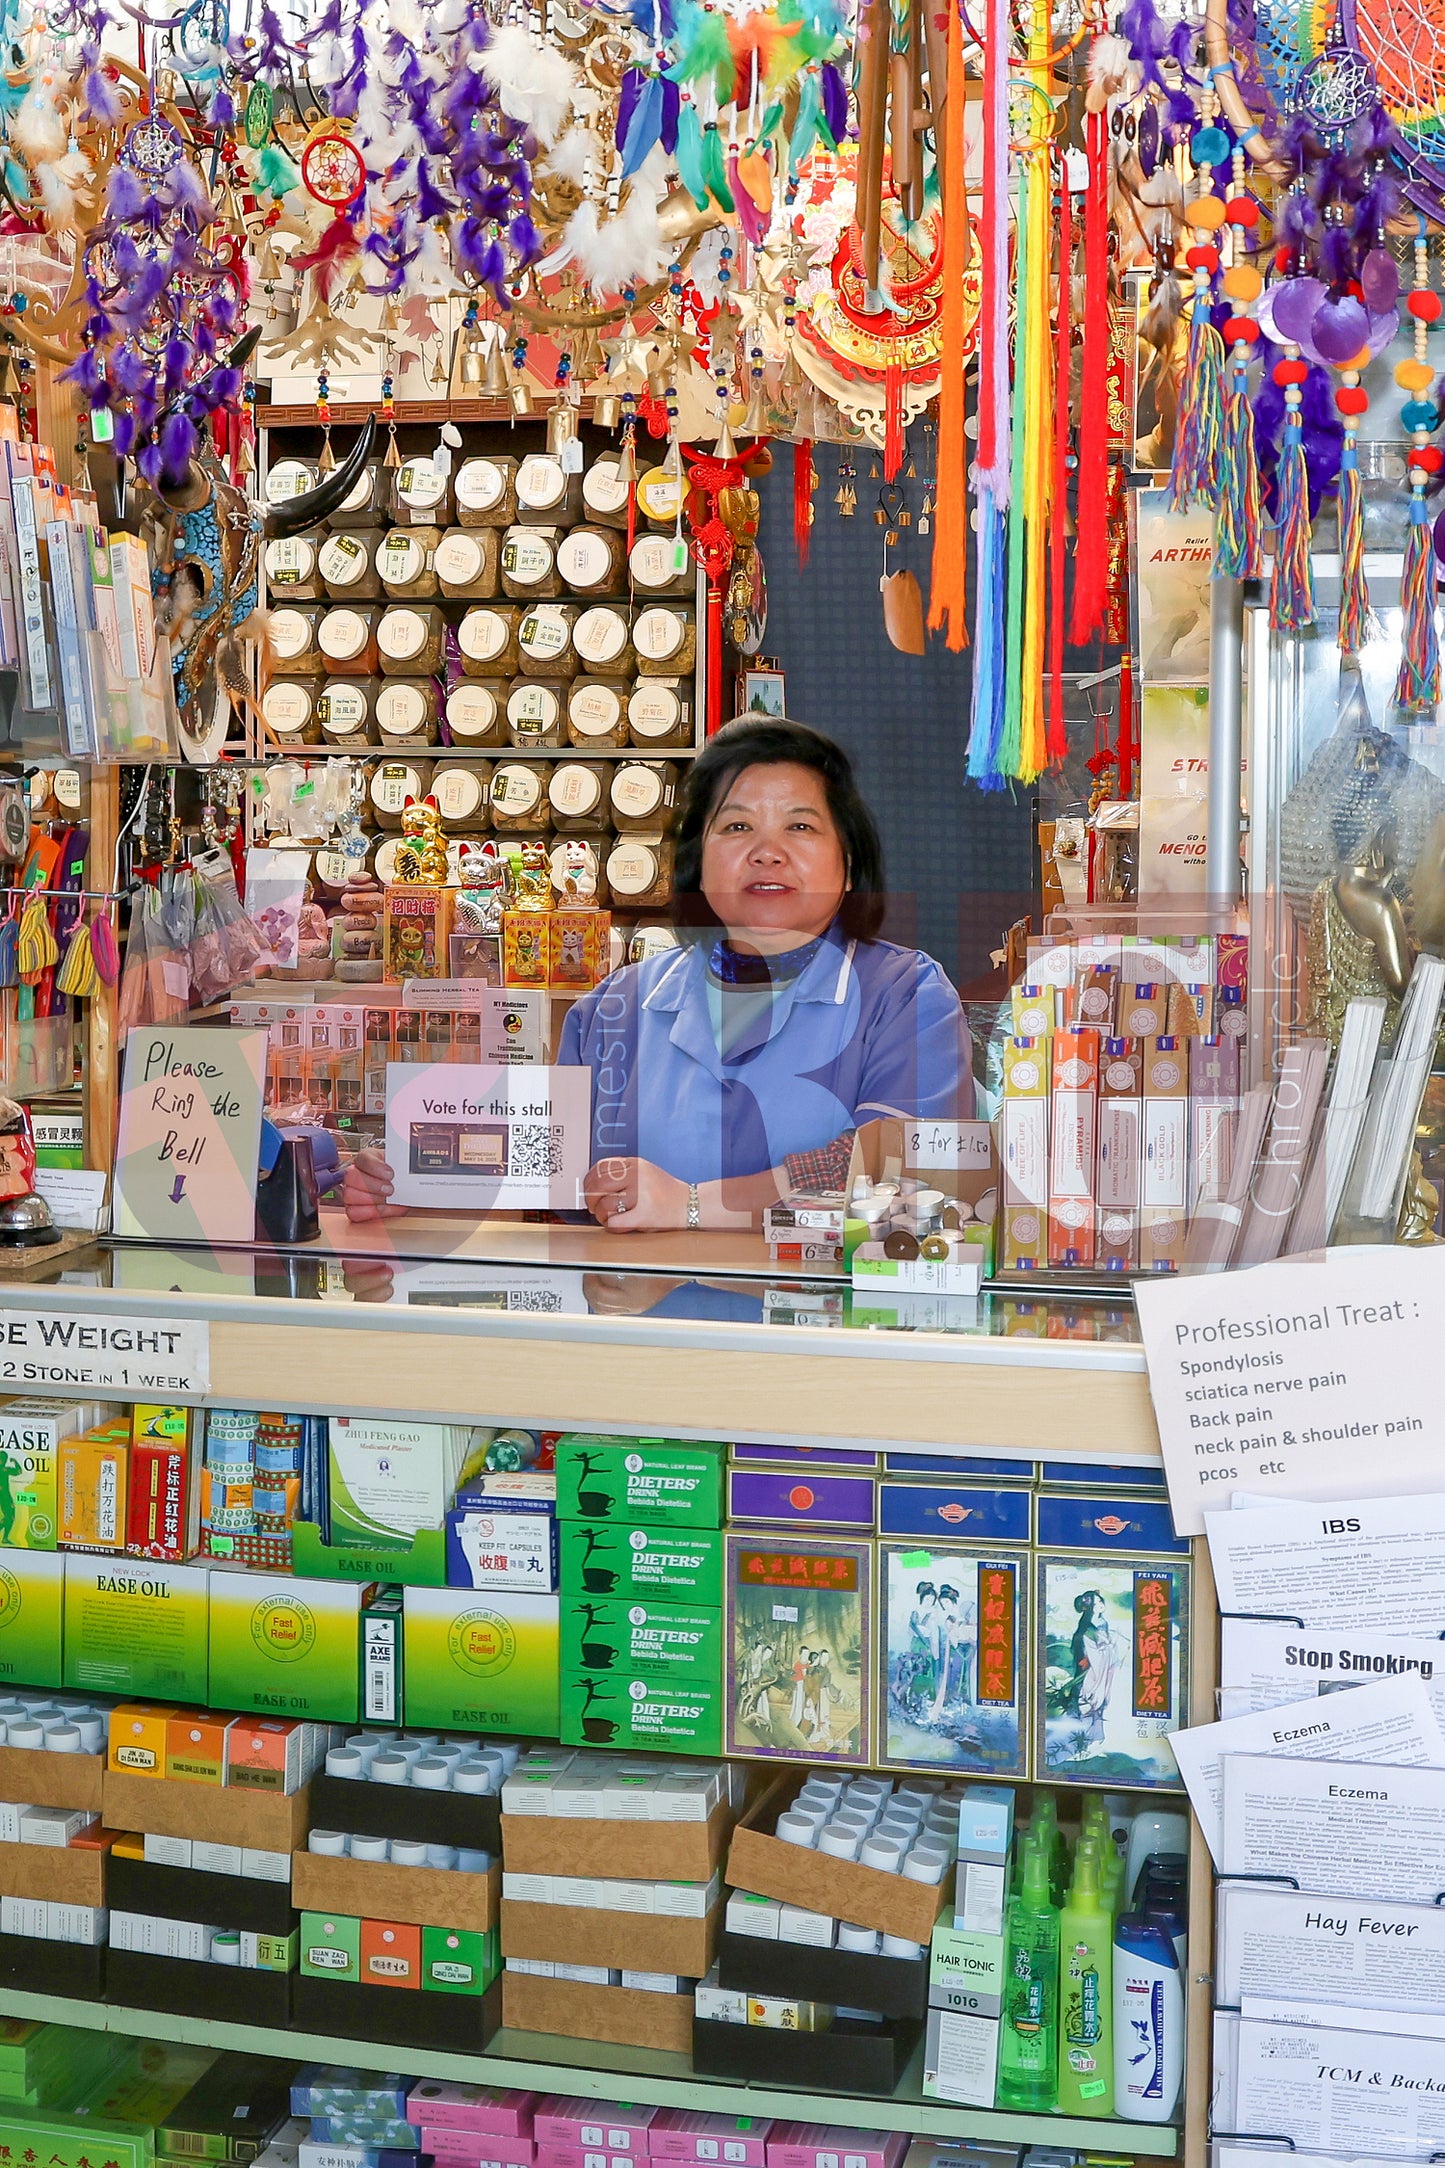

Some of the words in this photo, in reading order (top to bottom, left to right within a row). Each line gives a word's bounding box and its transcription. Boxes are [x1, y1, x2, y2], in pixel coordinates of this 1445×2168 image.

[136, 606, 149, 674] MEDITATION
[143, 1041, 224, 1082] Please
[151, 1086, 195, 1120] Ring
[210, 1091, 241, 1118] the
[422, 1099, 457, 1115] Vote
[462, 1098, 484, 1115] for
[489, 1100, 516, 1116] this
[521, 1100, 553, 1117] stall
[157, 1130, 207, 1165] Bell
[910, 1131, 920, 1151] 8
[928, 1128, 951, 1153] for
[1076, 1116, 1084, 1171] PYRAMIDS
[1175, 1306, 1331, 1346] Professional
[1335, 1300, 1405, 1327] Treat
[37, 1320, 181, 1354] WEIGHT
[1180, 1350, 1284, 1378] Spondylosis
[3, 1362, 17, 1378] 2
[23, 1363, 94, 1384] STONE
[99, 1374, 113, 1385] IN
[121, 1369, 129, 1385] 1
[138, 1375, 192, 1390] WEEK
[1185, 1380, 1249, 1402] sciatica
[1253, 1376, 1303, 1396] nerve
[1308, 1371, 1347, 1392] pain
[1190, 1410, 1231, 1429] Back
[1235, 1407, 1273, 1428] pain
[344, 1429, 368, 1439] ZHUI
[370, 1431, 397, 1441] FENG
[399, 1433, 421, 1442] GAO
[1194, 1435, 1235, 1455] neck
[1239, 1433, 1278, 1454] pain
[1282, 1430, 1298, 1446] &
[1301, 1420, 1380, 1444] shoulder
[1384, 1416, 1424, 1438] pain
[24, 1457, 50, 1473] OIL
[1198, 1465, 1239, 1485] pcos
[1259, 1459, 1287, 1476] etc
[102, 1463, 115, 1539] 跌打万花油
[164, 1454, 182, 1549] 斧标正红花油
[627, 1488, 660, 1497] DRINK
[1321, 1518, 1361, 1535] IBS
[479, 1542, 494, 1550] KEEP
[509, 1543, 542, 1552] CAPSULES
[113, 1567, 129, 1575] NEW
[133, 1569, 150, 1577] LOCK
[338, 1560, 371, 1573] EASE
[376, 1562, 396, 1574] OIL
[632, 1565, 664, 1574] DRINK
[96, 1575, 137, 1594] EASE
[141, 1579, 170, 1599] OIL
[273, 1617, 293, 1629] Fast
[270, 1629, 298, 1641] Relief
[471, 1631, 492, 1642] Fast
[370, 1646, 391, 1656] AXE
[469, 1643, 496, 1655] Relief
[1285, 1645, 1333, 1670] Stop
[1339, 1650, 1434, 1681] Smoking
[254, 1692, 288, 1706] EASE
[982, 1699, 997, 1707] DIET
[998, 1700, 1010, 1708] TEA
[452, 1710, 486, 1723] EASE
[491, 1712, 511, 1724] OIL
[1272, 1721, 1332, 1744] Eczema
[1328, 1784, 1388, 1801] Eczema
[1302, 1853, 1329, 1861] Chinese
[1330, 1855, 1352, 1863] Herbal
[1352, 1857, 1383, 1866] Medicine
[1394, 1860, 1423, 1869] Effective
[1304, 1912, 1348, 1936] Hay
[1358, 1917, 1419, 1937] Fever
[312, 1949, 328, 1957] SUAN
[331, 1951, 345, 1959] ZAO
[331, 1958, 345, 1966] WAN
[936, 1953, 961, 1968] HAIR
[963, 1957, 995, 1973] TONIC
[947, 1992, 979, 2009] 101G
[1316, 2064, 1364, 2083] TCM
[1368, 2071, 1383, 2086] &
